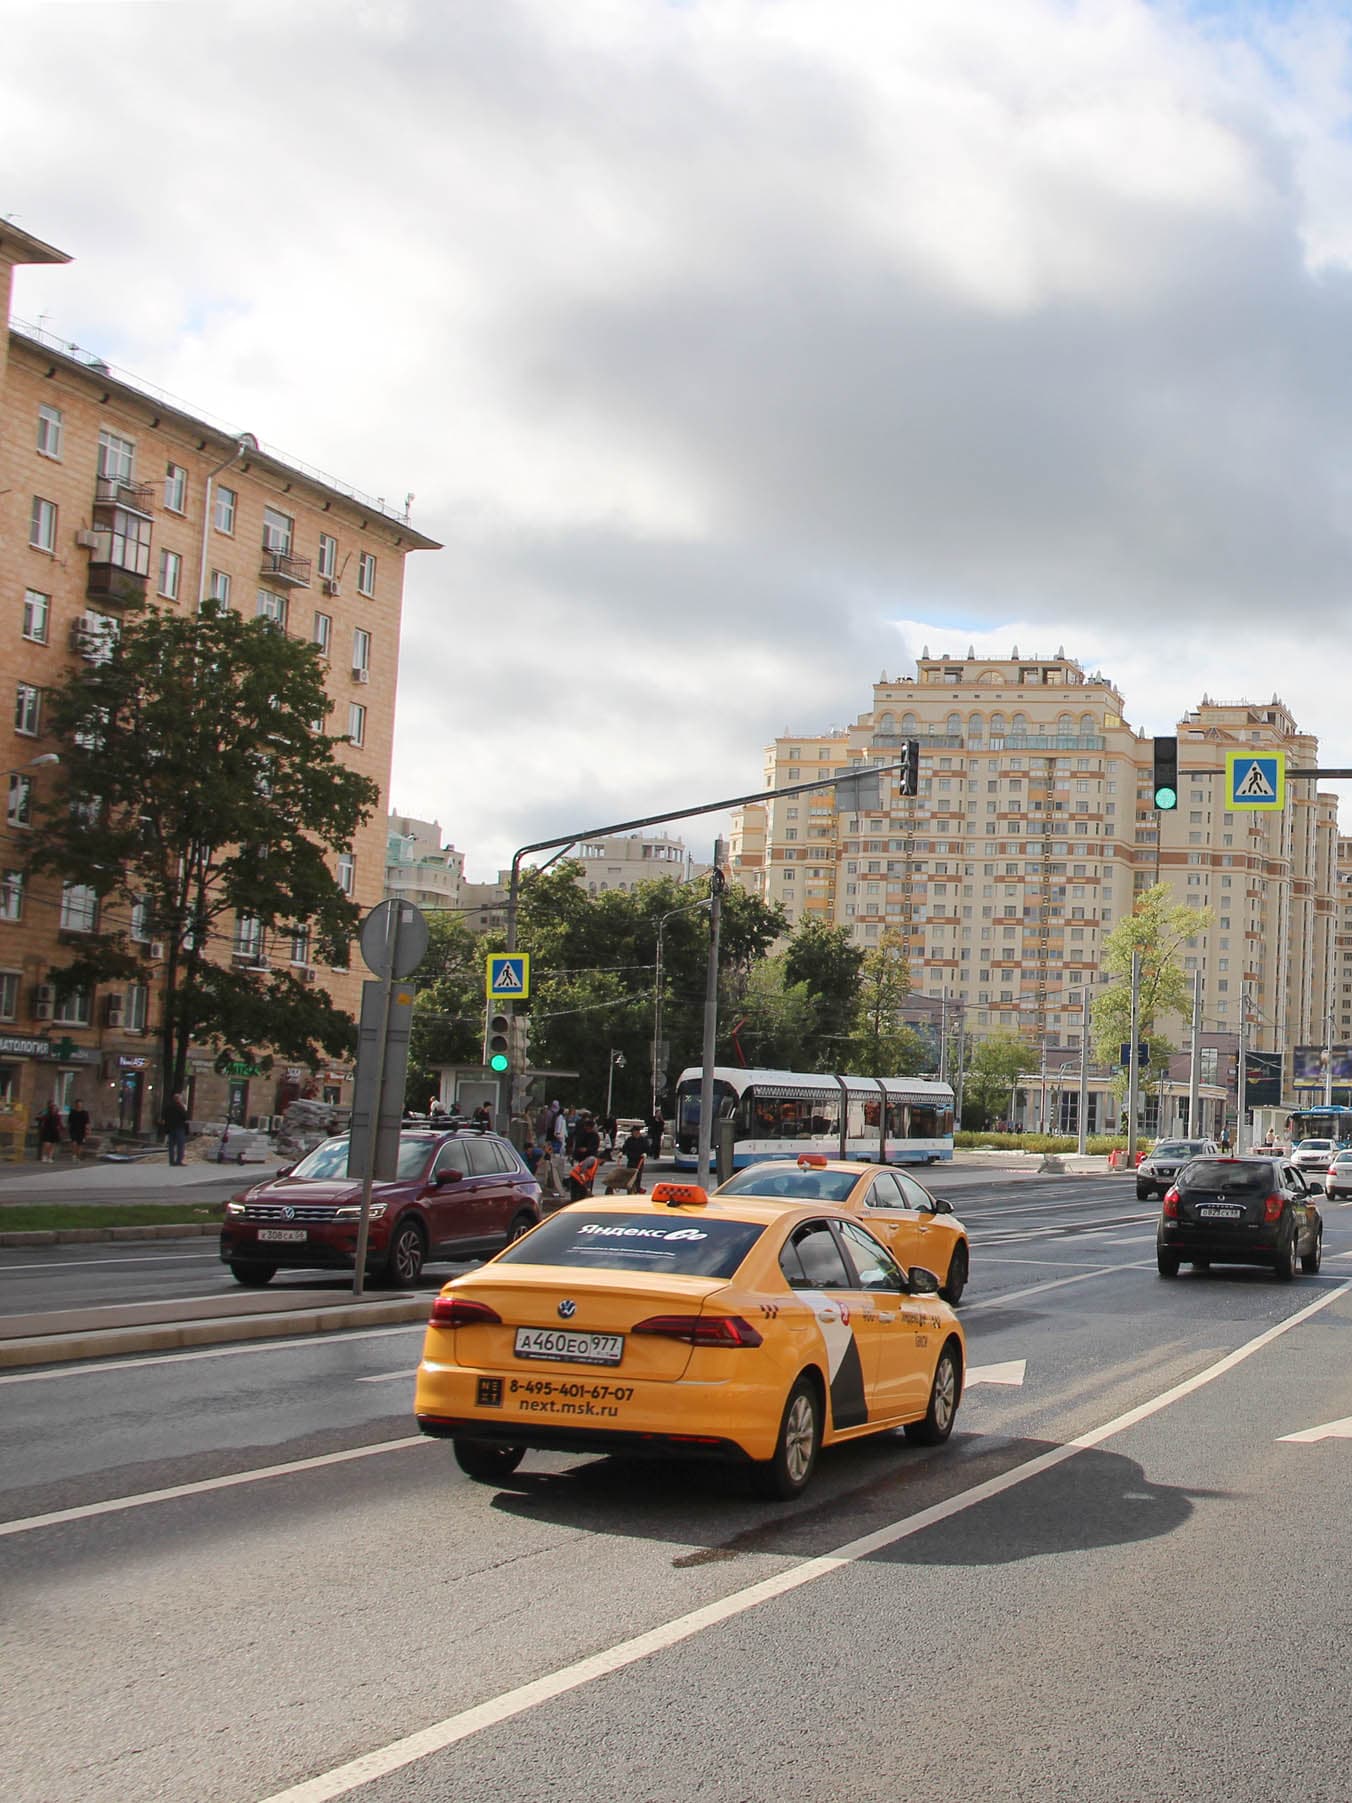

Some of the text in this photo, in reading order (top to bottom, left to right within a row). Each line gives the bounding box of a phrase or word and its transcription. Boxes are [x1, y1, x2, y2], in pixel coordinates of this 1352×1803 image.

[577, 1224, 667, 1238] Яндекс
[510, 1379, 635, 1401] 8-495-401-67-07
[519, 1399, 619, 1417] next.msk.ru
